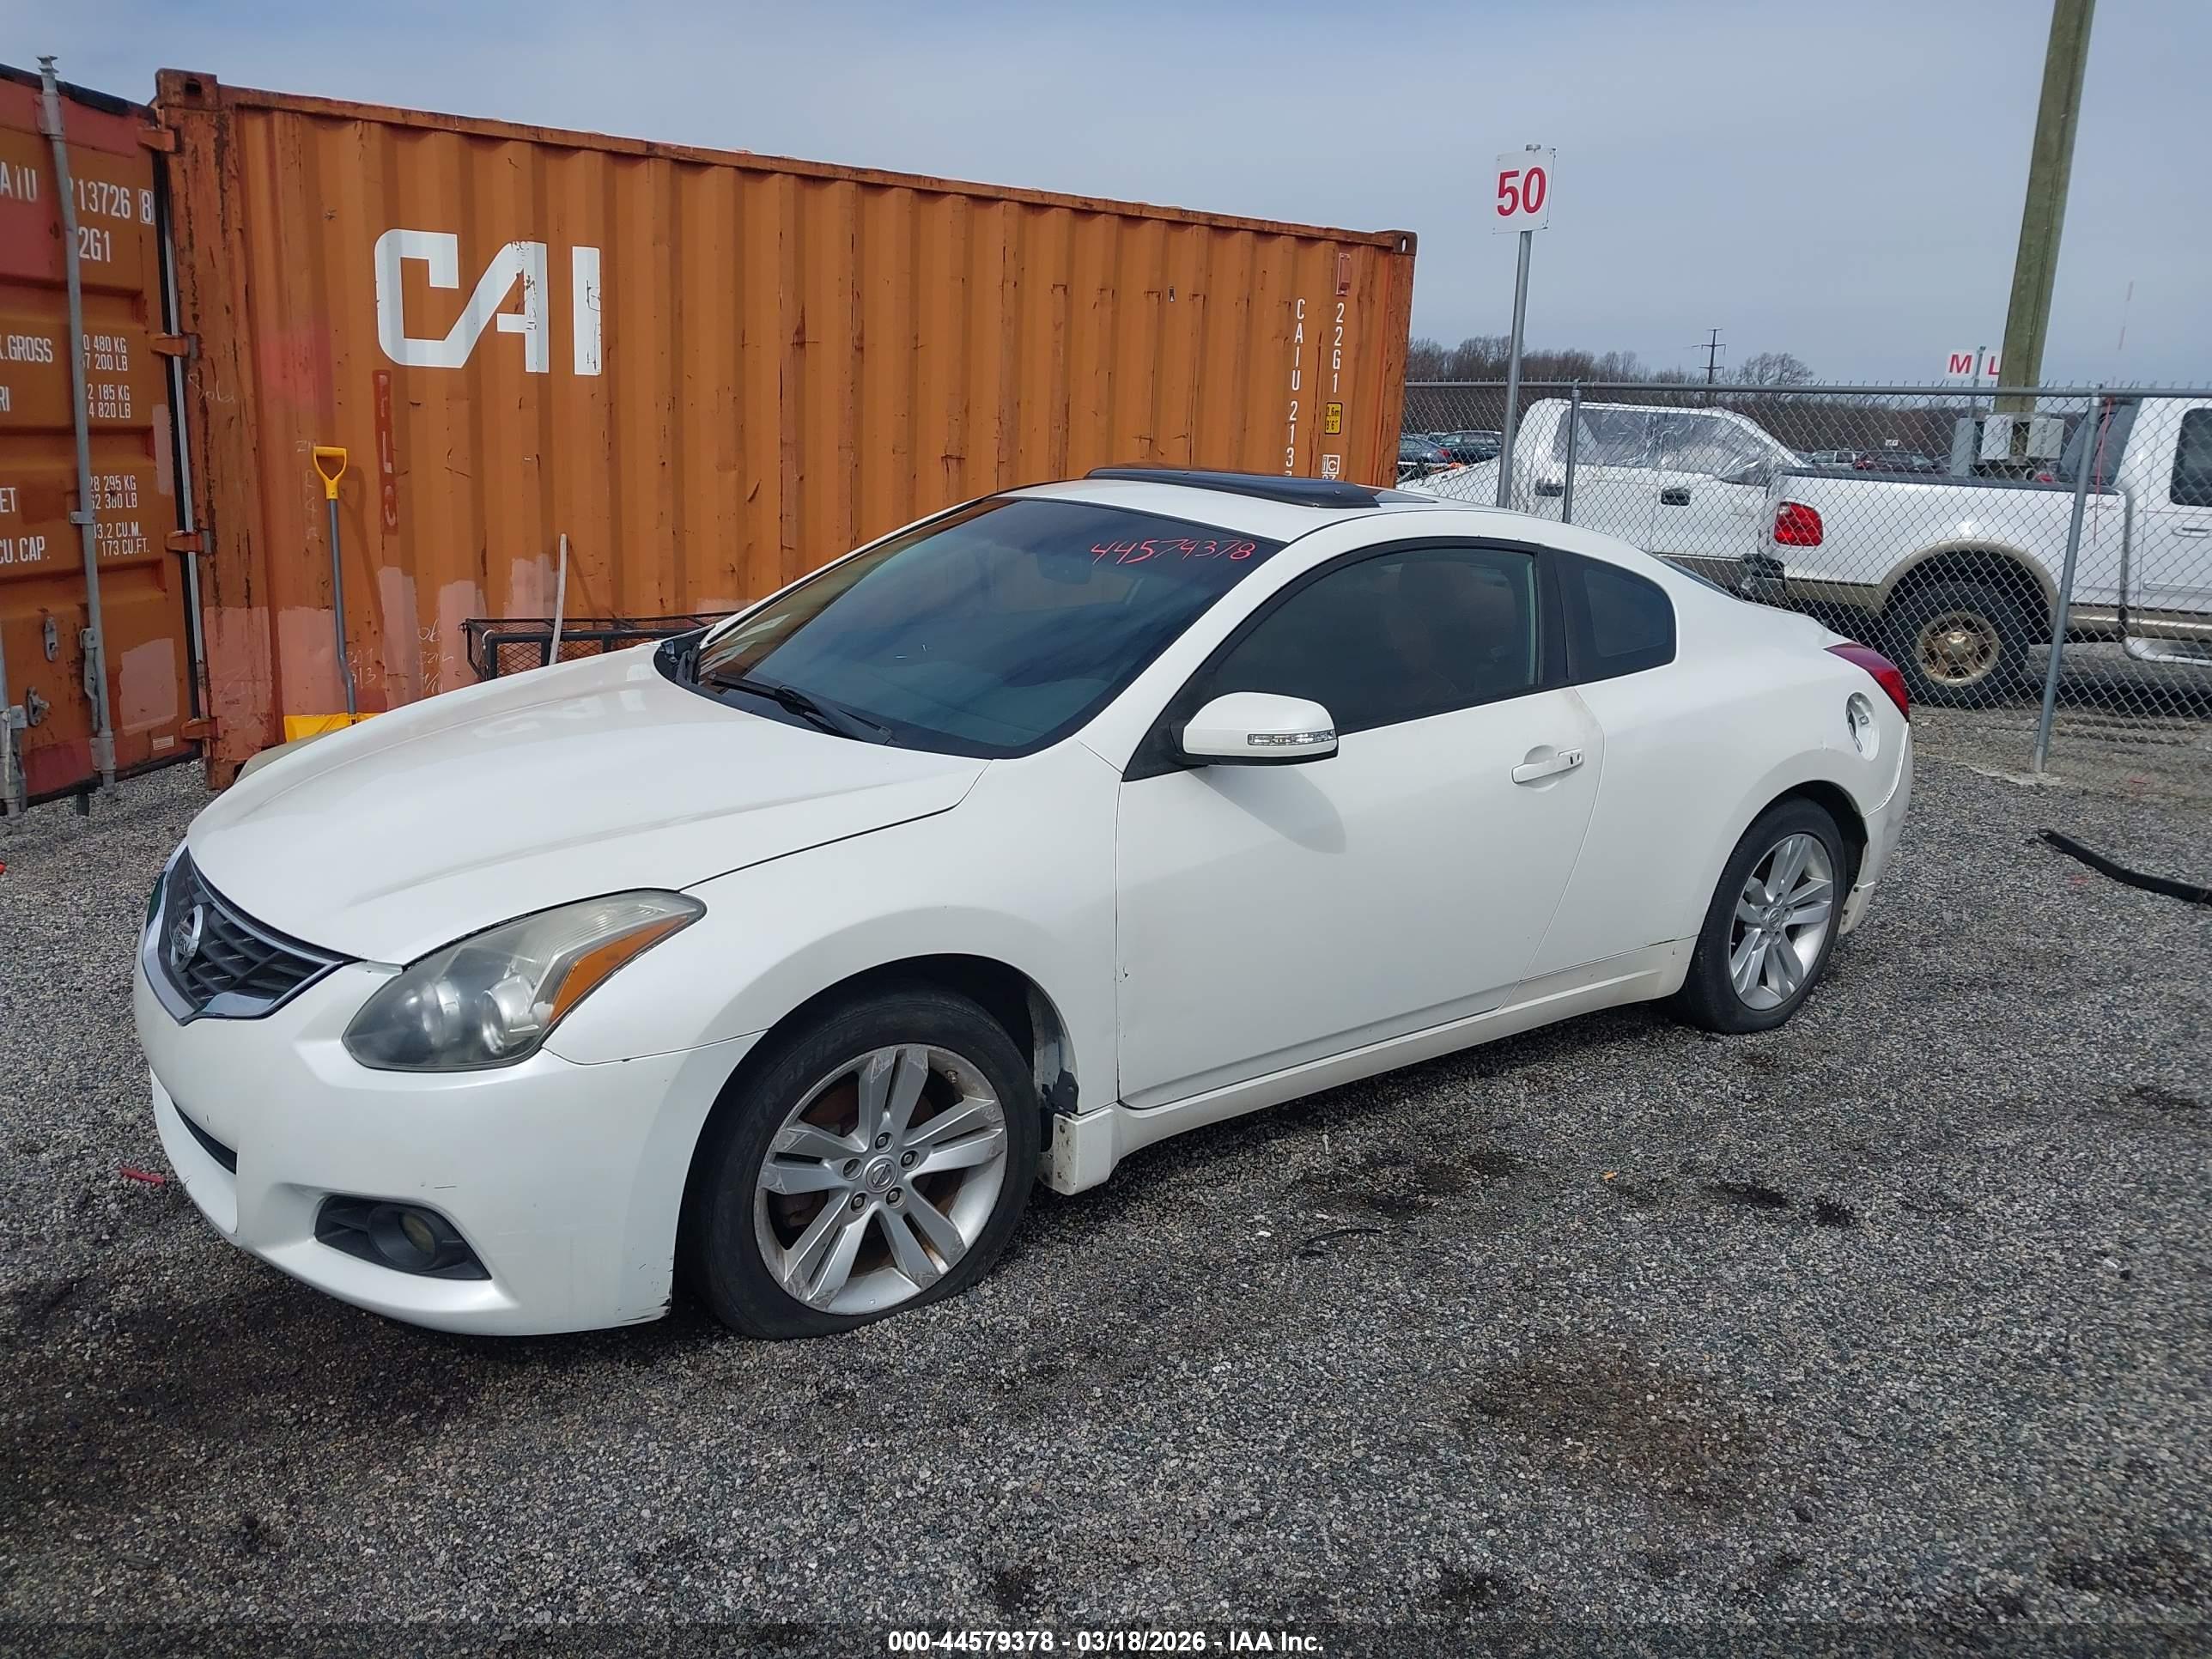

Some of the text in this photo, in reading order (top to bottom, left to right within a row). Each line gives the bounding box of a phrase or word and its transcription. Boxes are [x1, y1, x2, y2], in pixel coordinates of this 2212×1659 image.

[1498, 167, 1547, 216] 50
[374, 228, 601, 376] CAI
[94, 335, 112, 353] 480
[113, 336, 127, 355] KG
[1291, 298, 1306, 391] CAIU
[1333, 302, 1345, 393] 22G1
[95, 353, 113, 371] 200
[115, 355, 128, 372] LB
[1948, 353, 1972, 374] M
[88, 383, 94, 400] 2
[99, 384, 115, 400] 185
[118, 384, 130, 401] KG
[88, 401, 131, 419] 4 820 LB
[103, 475, 122, 491] 295
[124, 474, 137, 491] KG
[125, 492, 137, 508] LB
[101, 540, 119, 557] 173
[1091, 538, 1256, 565] 44579378
